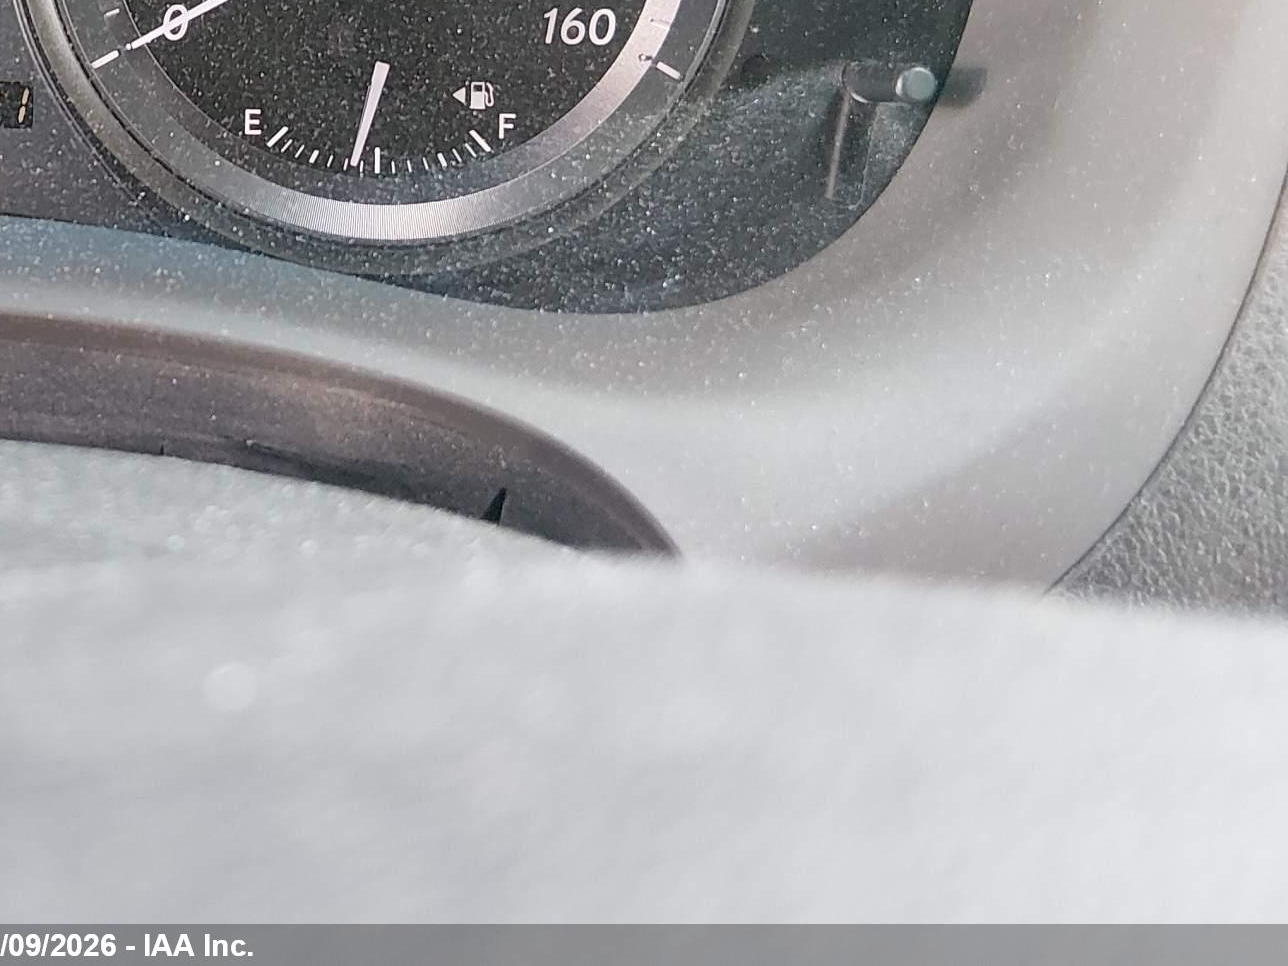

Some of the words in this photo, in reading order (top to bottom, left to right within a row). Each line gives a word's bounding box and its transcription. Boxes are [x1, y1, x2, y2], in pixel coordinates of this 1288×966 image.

[162, 4, 189, 41] 0
[542, 7, 616, 46] 160
[244, 108, 262, 135] E
[498, 113, 517, 139] F
